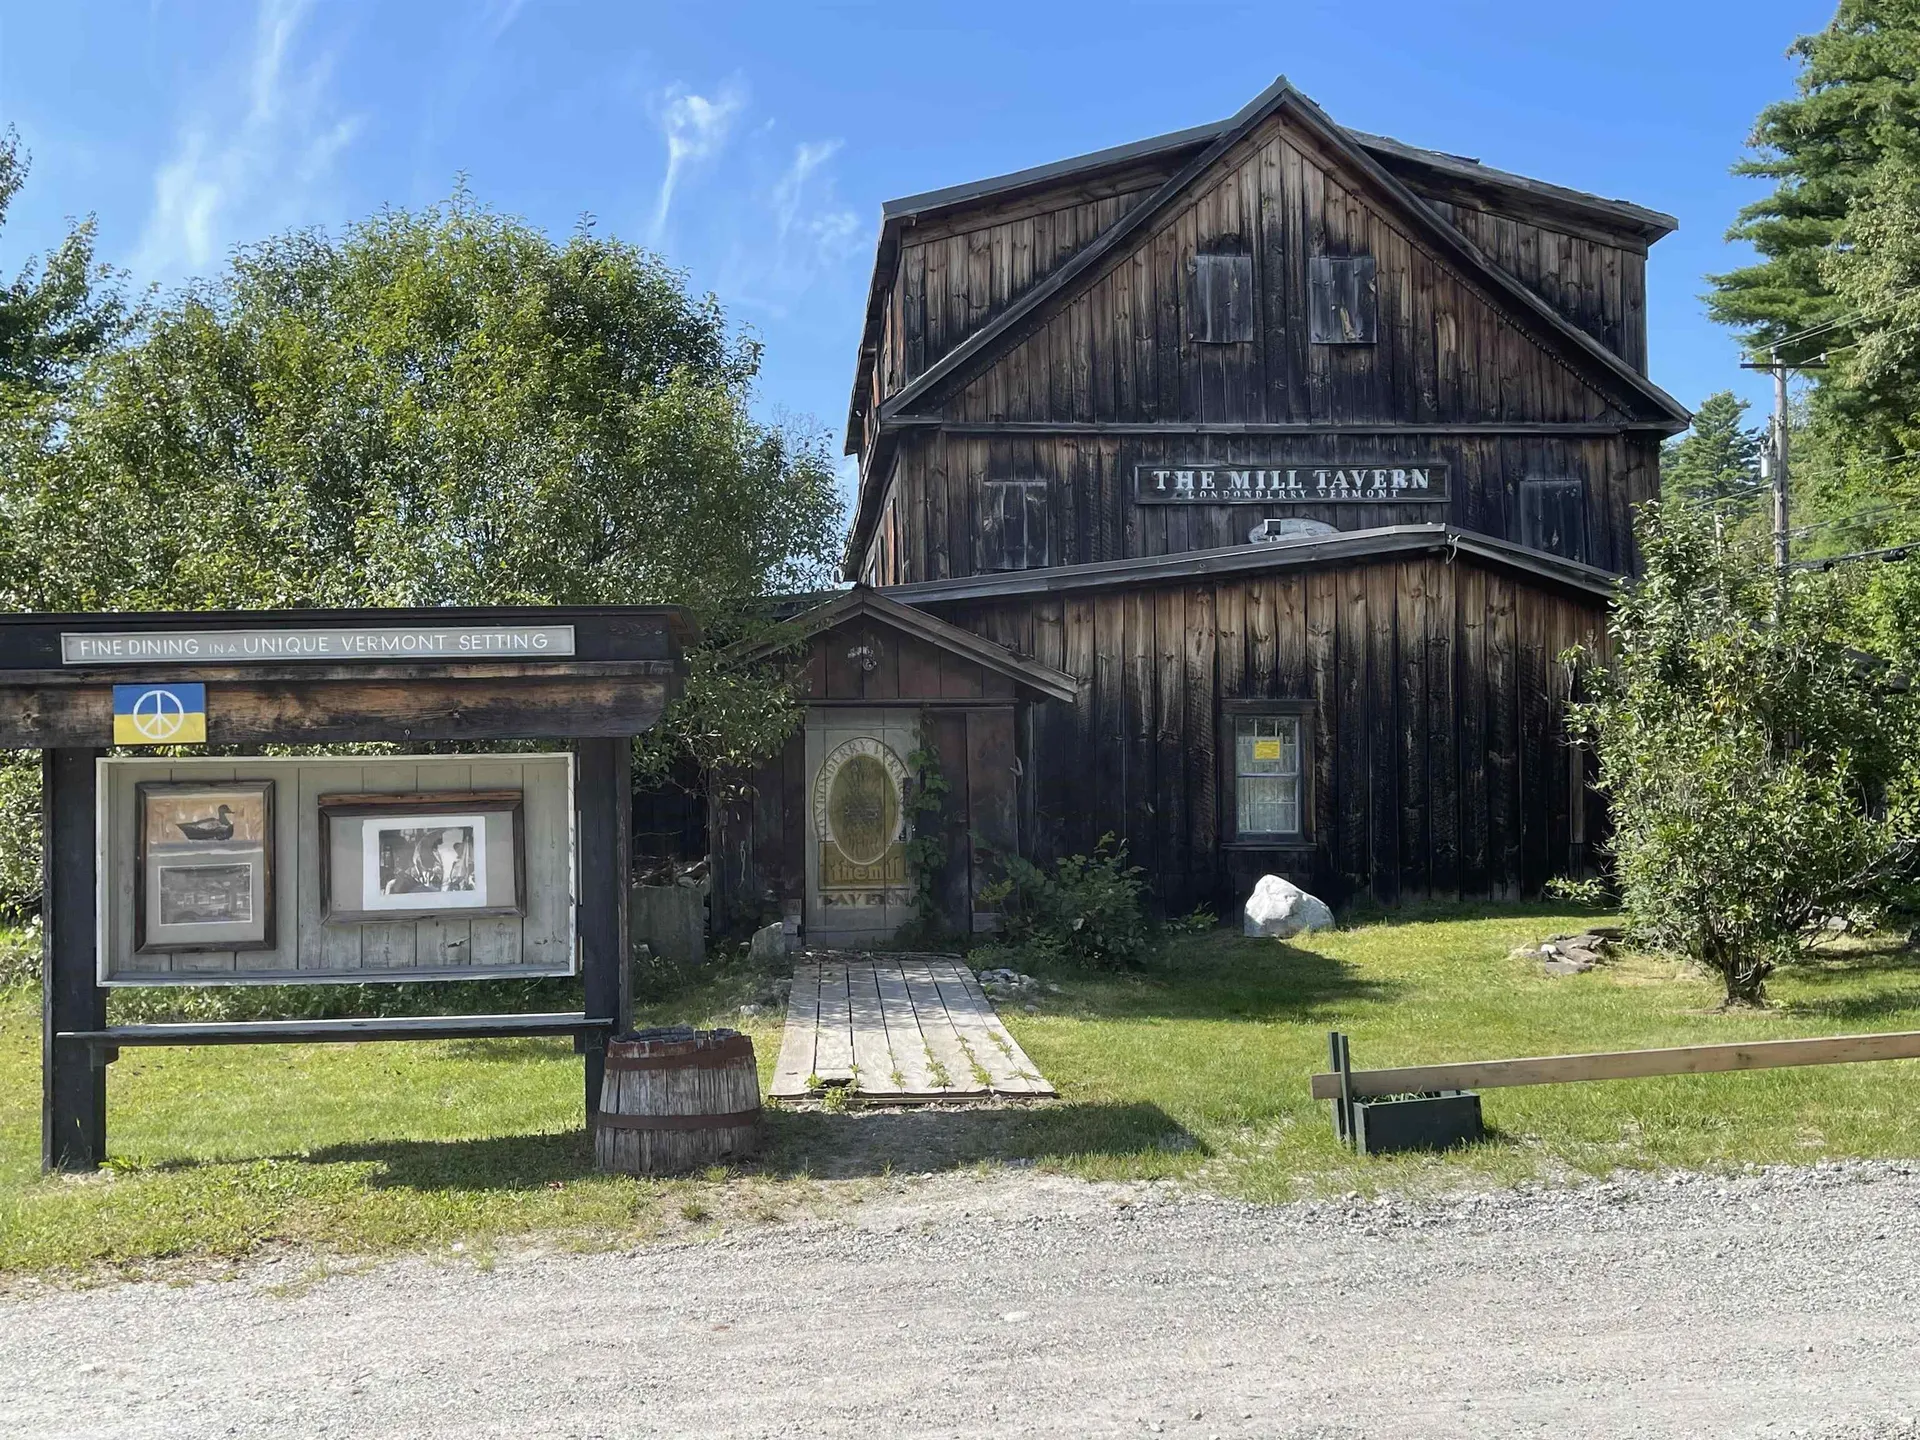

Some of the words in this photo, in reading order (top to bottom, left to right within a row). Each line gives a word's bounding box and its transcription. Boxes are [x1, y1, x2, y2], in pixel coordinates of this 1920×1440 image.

[1152, 469, 1216, 490] THE
[1228, 469, 1303, 490] MILL
[1312, 468, 1430, 490] TAVERN
[1317, 488, 1399, 499] VERMONT
[80, 640, 123, 657] FINE
[128, 638, 200, 655] DINING
[209, 643, 225, 654] IN
[227, 643, 237, 654] A
[243, 635, 330, 654] UNIQUE
[341, 634, 448, 652] VERMONT
[458, 632, 549, 651] SETTING
